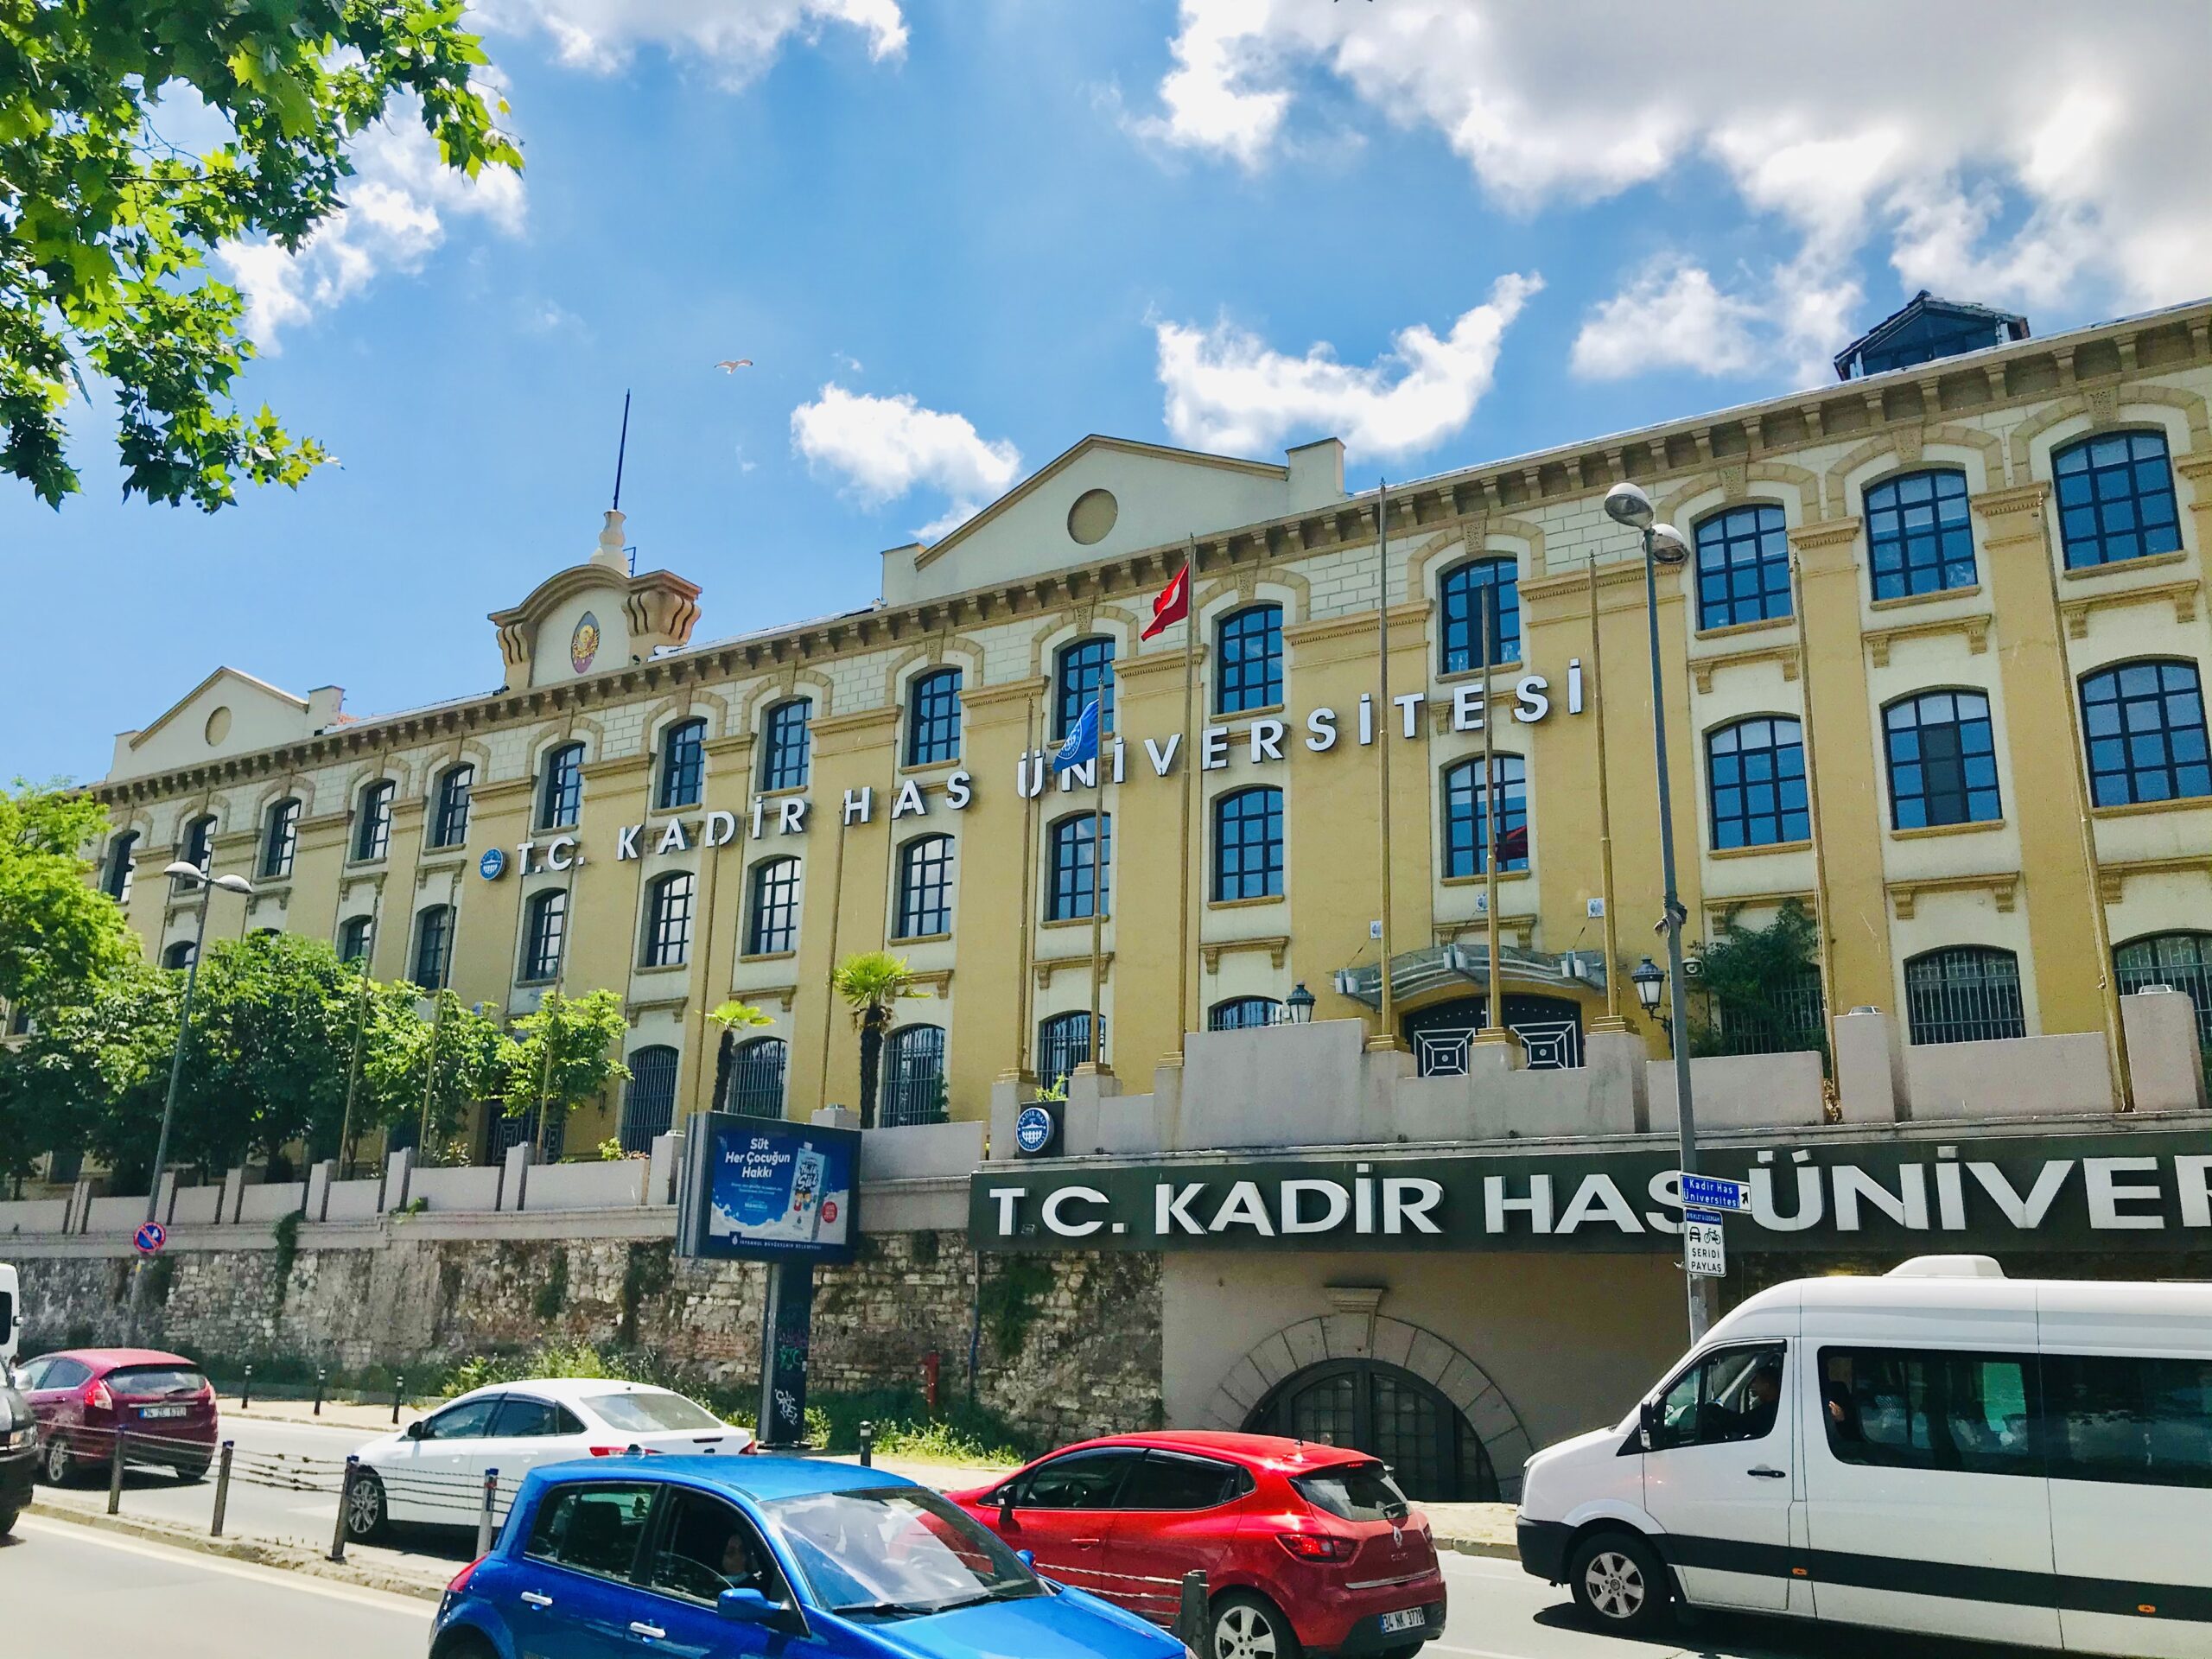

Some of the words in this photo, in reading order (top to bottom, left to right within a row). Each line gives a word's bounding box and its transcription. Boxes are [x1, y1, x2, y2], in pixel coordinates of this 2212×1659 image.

[517, 836, 585, 875] T.C.
[616, 796, 807, 861] KADİR
[843, 770, 973, 826] HAS
[1016, 658, 1582, 798] ÜNİVERSİTESİ
[750, 1137, 769, 1149] Süt
[725, 1151, 745, 1163] Her
[747, 1151, 791, 1166] Çocuğun
[741, 1166, 772, 1178] Hakkı
[1689, 1179, 1714, 1191] Kadir
[1717, 1182, 1733, 1194] Has
[1155, 1163, 1446, 1237] KADİR
[1683, 1187, 1739, 1207] Üniversitesi
[1691, 1262, 1722, 1273] PAYLAŞ
